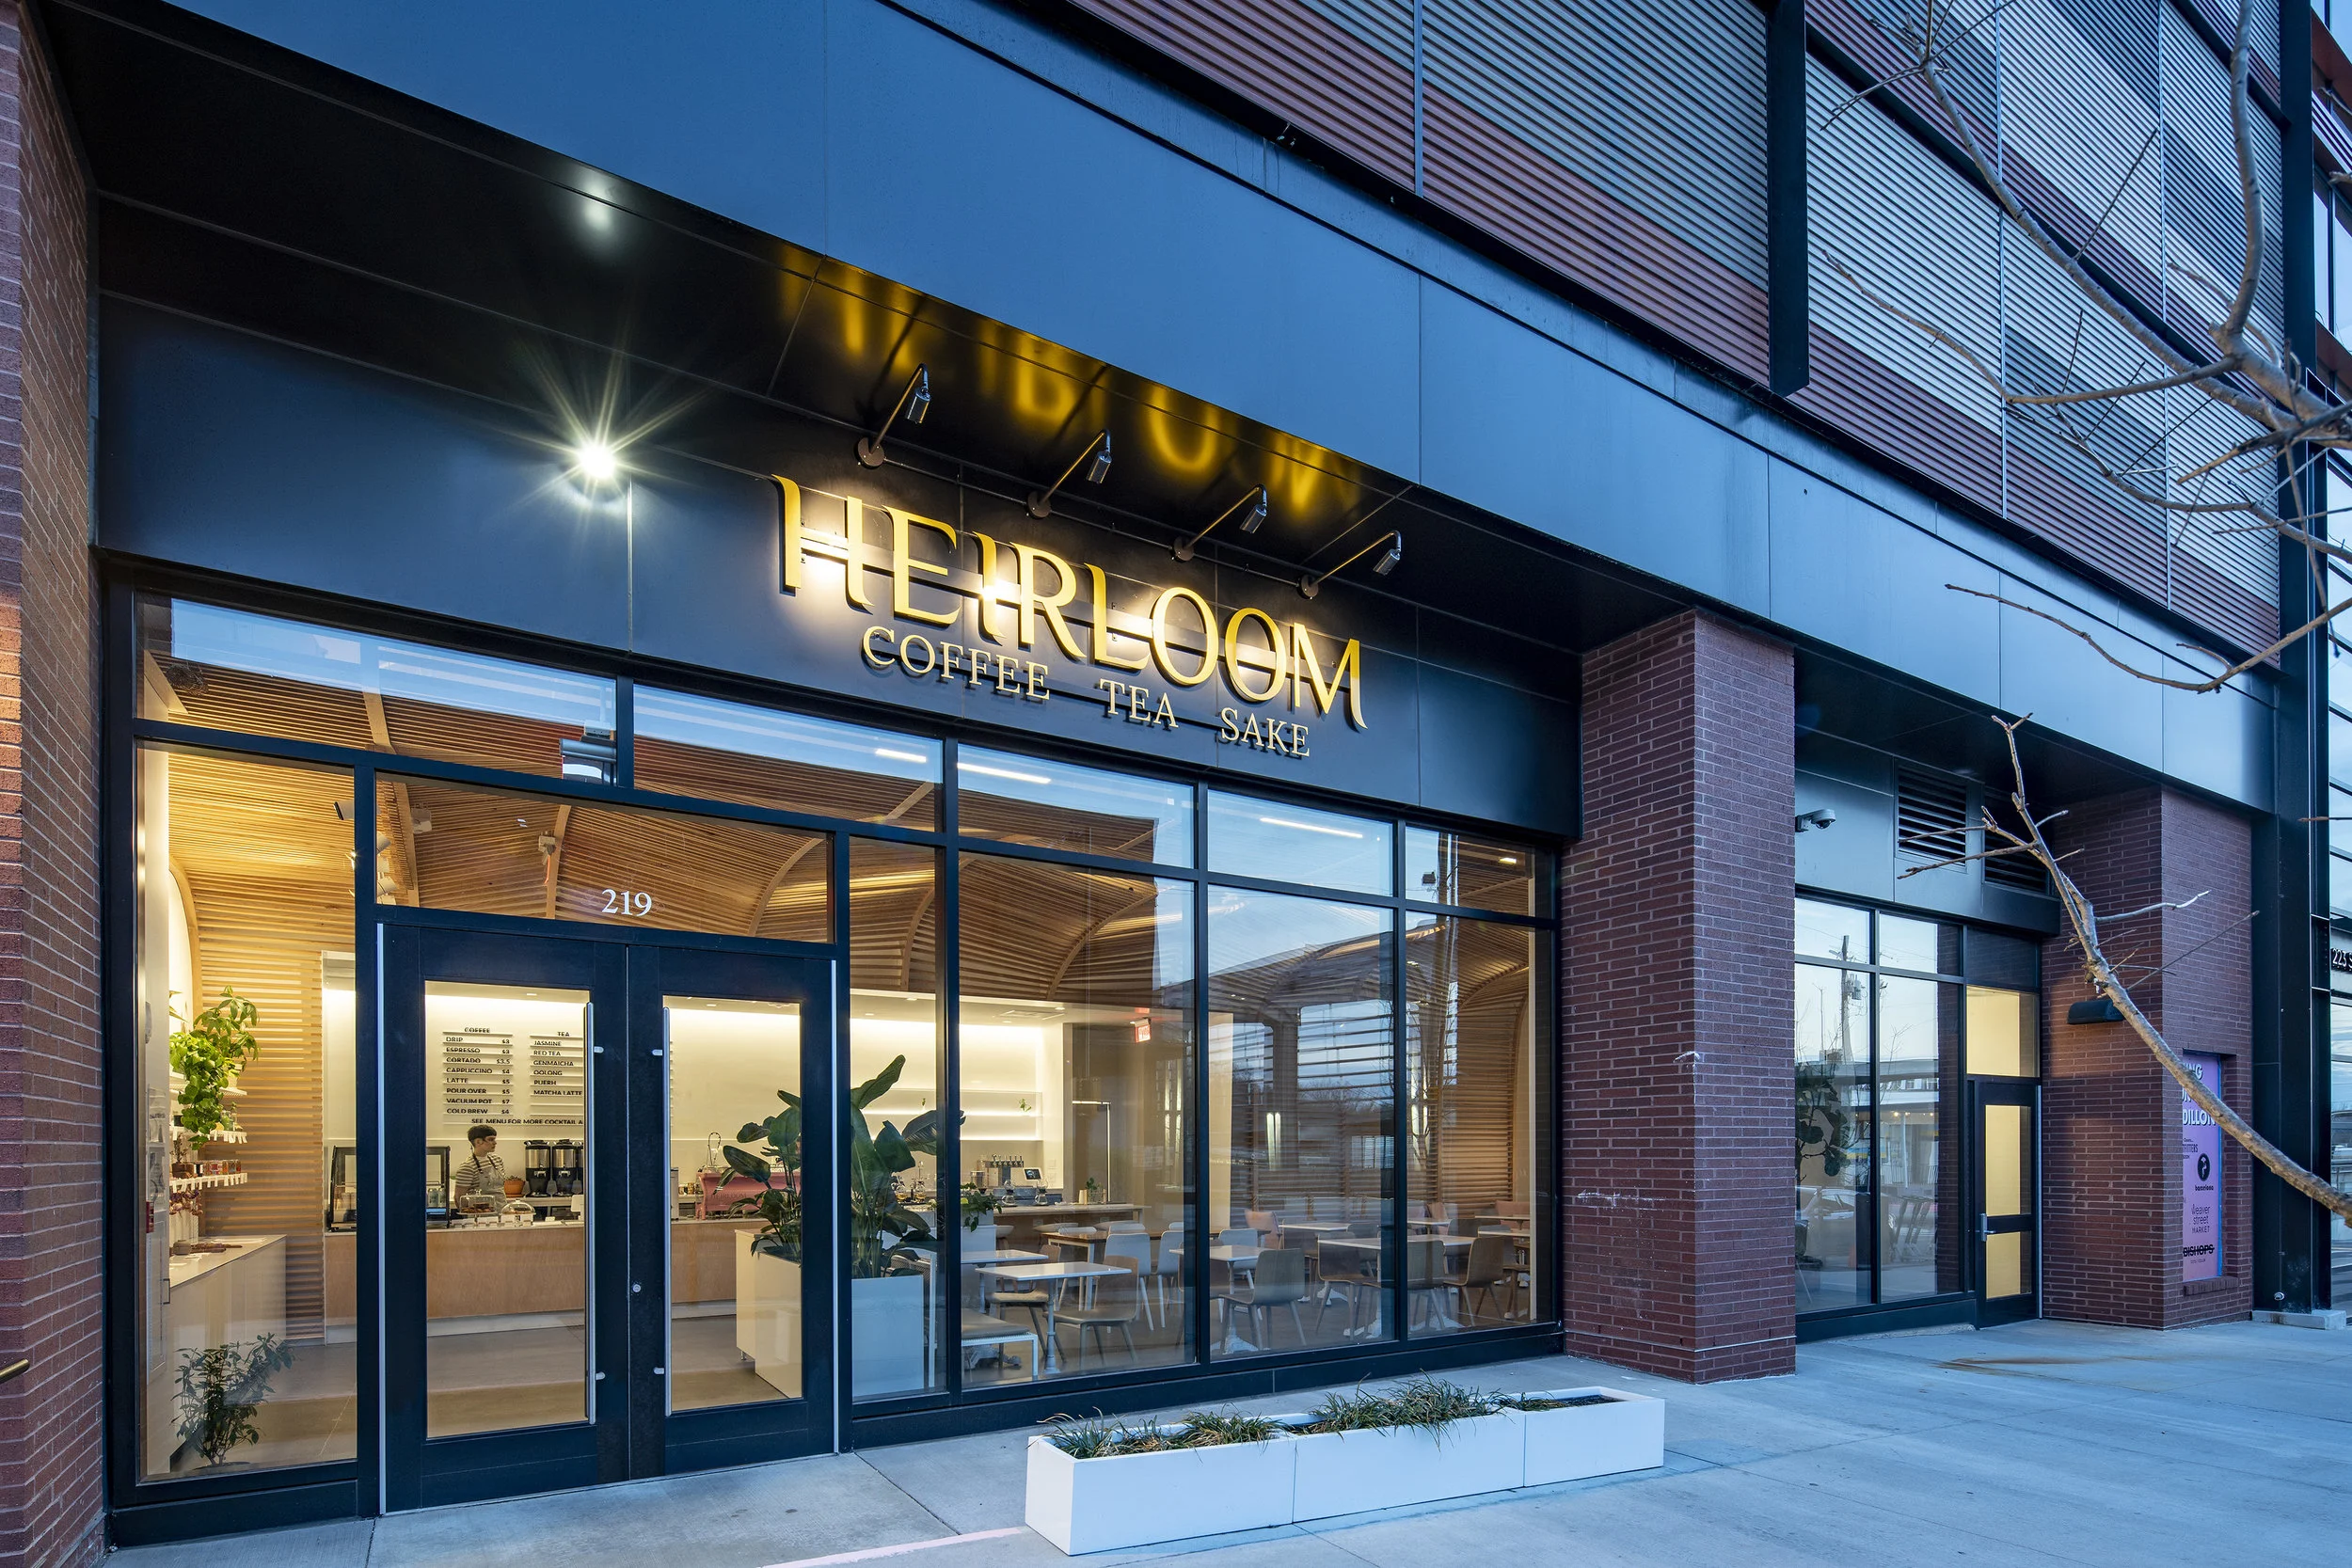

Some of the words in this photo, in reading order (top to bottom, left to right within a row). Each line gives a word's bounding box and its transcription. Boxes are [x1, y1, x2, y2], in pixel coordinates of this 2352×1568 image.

[771, 474, 1368, 729] HEIRLOOM
[862, 626, 1051, 700] COFFEE
[1099, 679, 1179, 728] TEA
[1219, 707, 1311, 758] SAKE
[601, 888, 653, 917] 219
[2333, 948, 2347, 967] 223
[2193, 1215, 2209, 1225] street
[2183, 1244, 2215, 1257] BISHOPS
